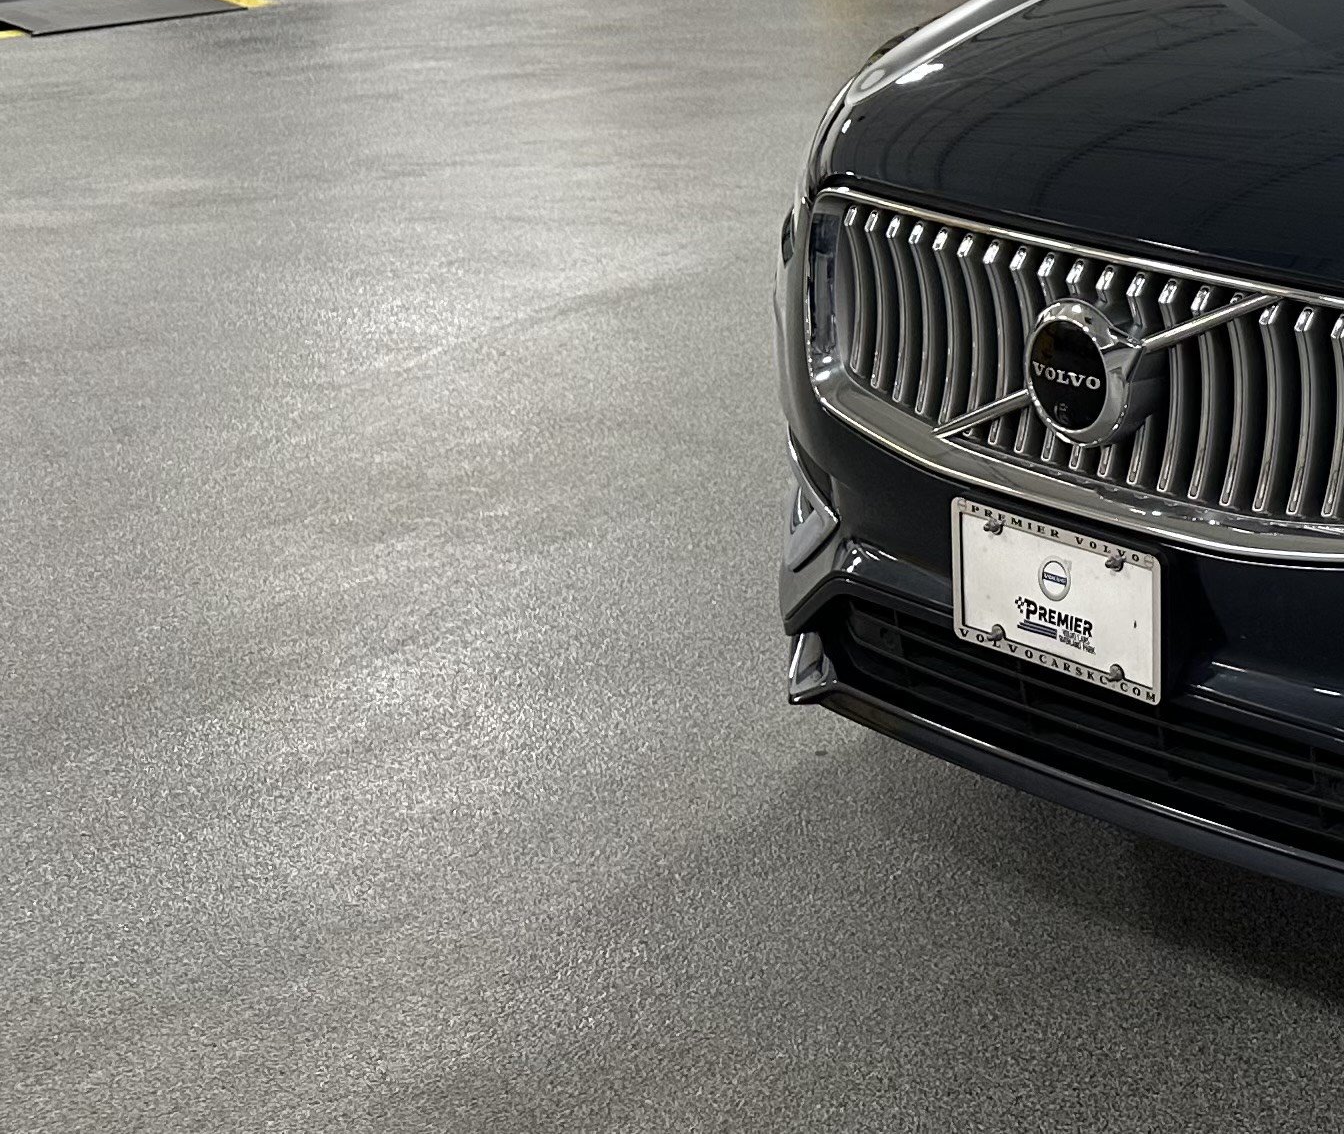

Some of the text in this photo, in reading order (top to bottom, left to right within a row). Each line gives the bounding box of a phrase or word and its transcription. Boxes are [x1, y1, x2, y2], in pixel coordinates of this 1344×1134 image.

[1032, 360, 1101, 390] VOLVO
[971, 504, 1140, 563] PREMIER VOLVO
[1025, 598, 1093, 638] PREMIER
